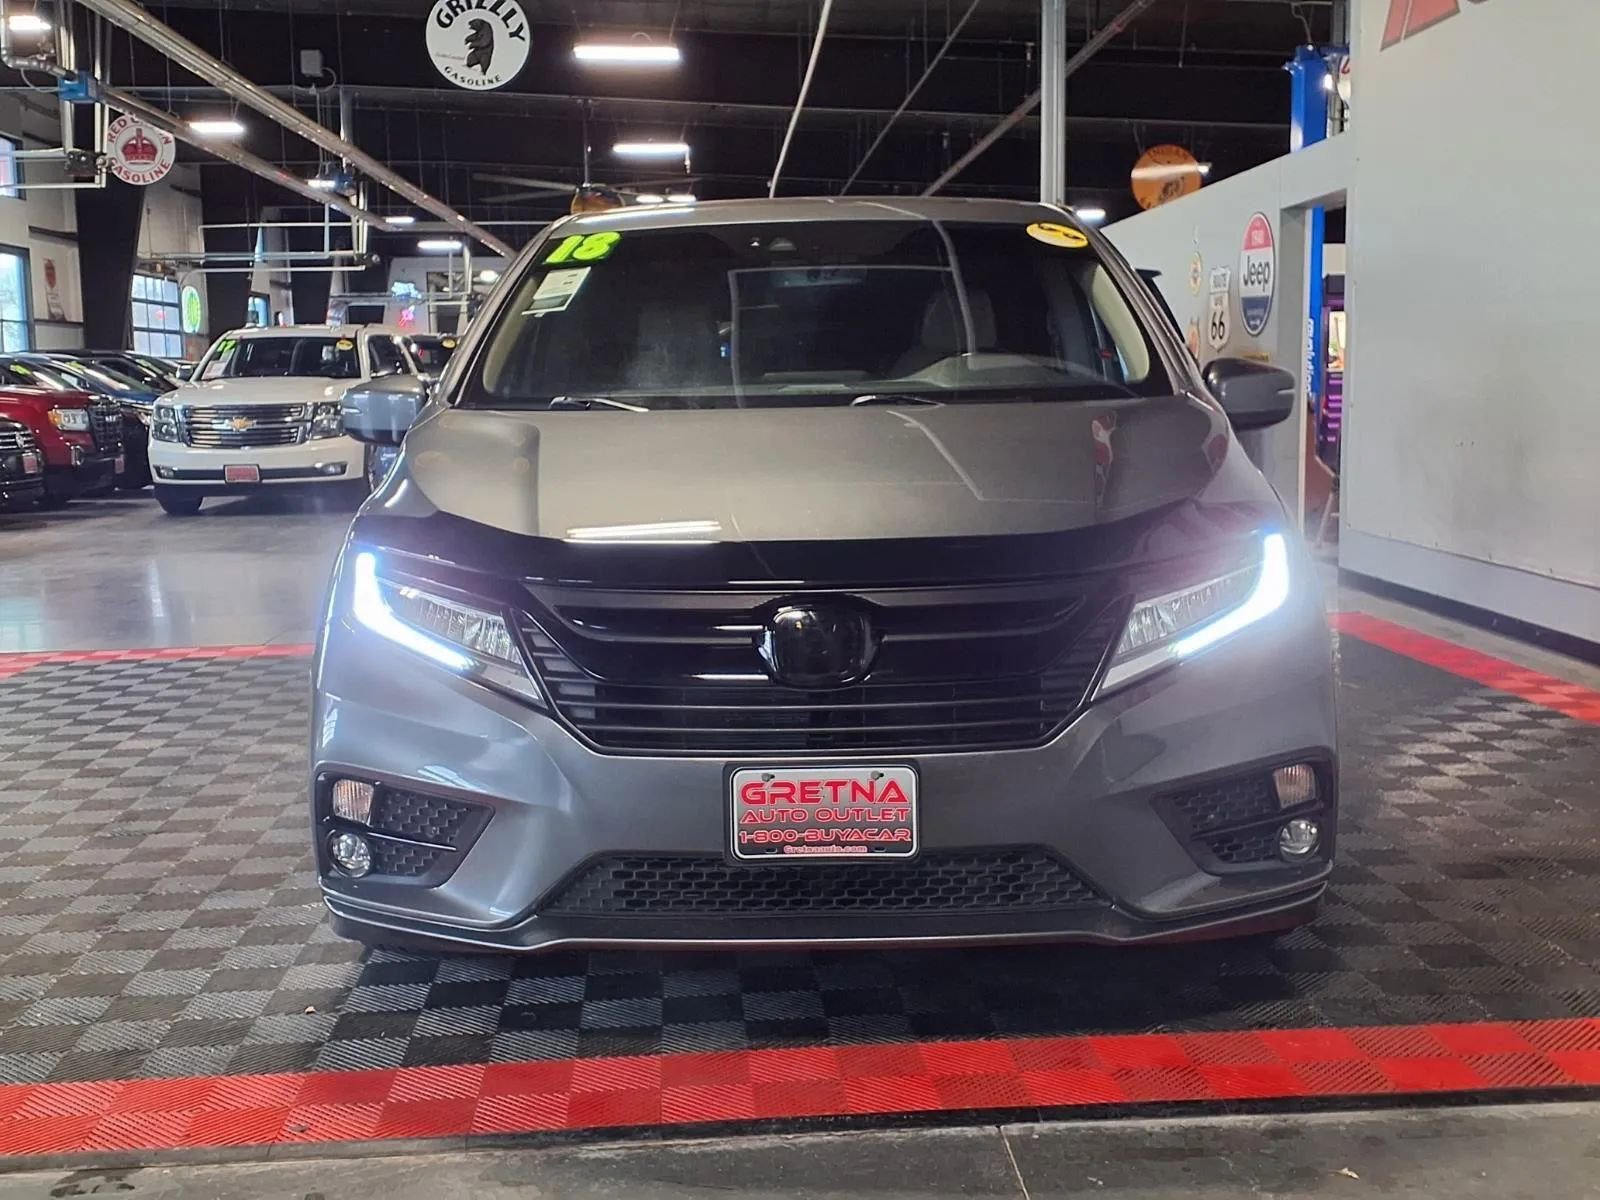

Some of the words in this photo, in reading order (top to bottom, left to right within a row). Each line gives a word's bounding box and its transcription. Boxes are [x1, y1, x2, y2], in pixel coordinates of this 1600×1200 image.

[444, 66, 502, 86] GASOLINE
[107, 118, 128, 144] RED
[545, 231, 621, 263] 18
[1243, 254, 1270, 293] Jeep
[1211, 311, 1226, 341] 66
[740, 779, 909, 805] GRETNA
[739, 808, 809, 825] AUTO
[815, 807, 912, 822] OUTLET
[738, 828, 912, 844] 1-800-BUYACAR
